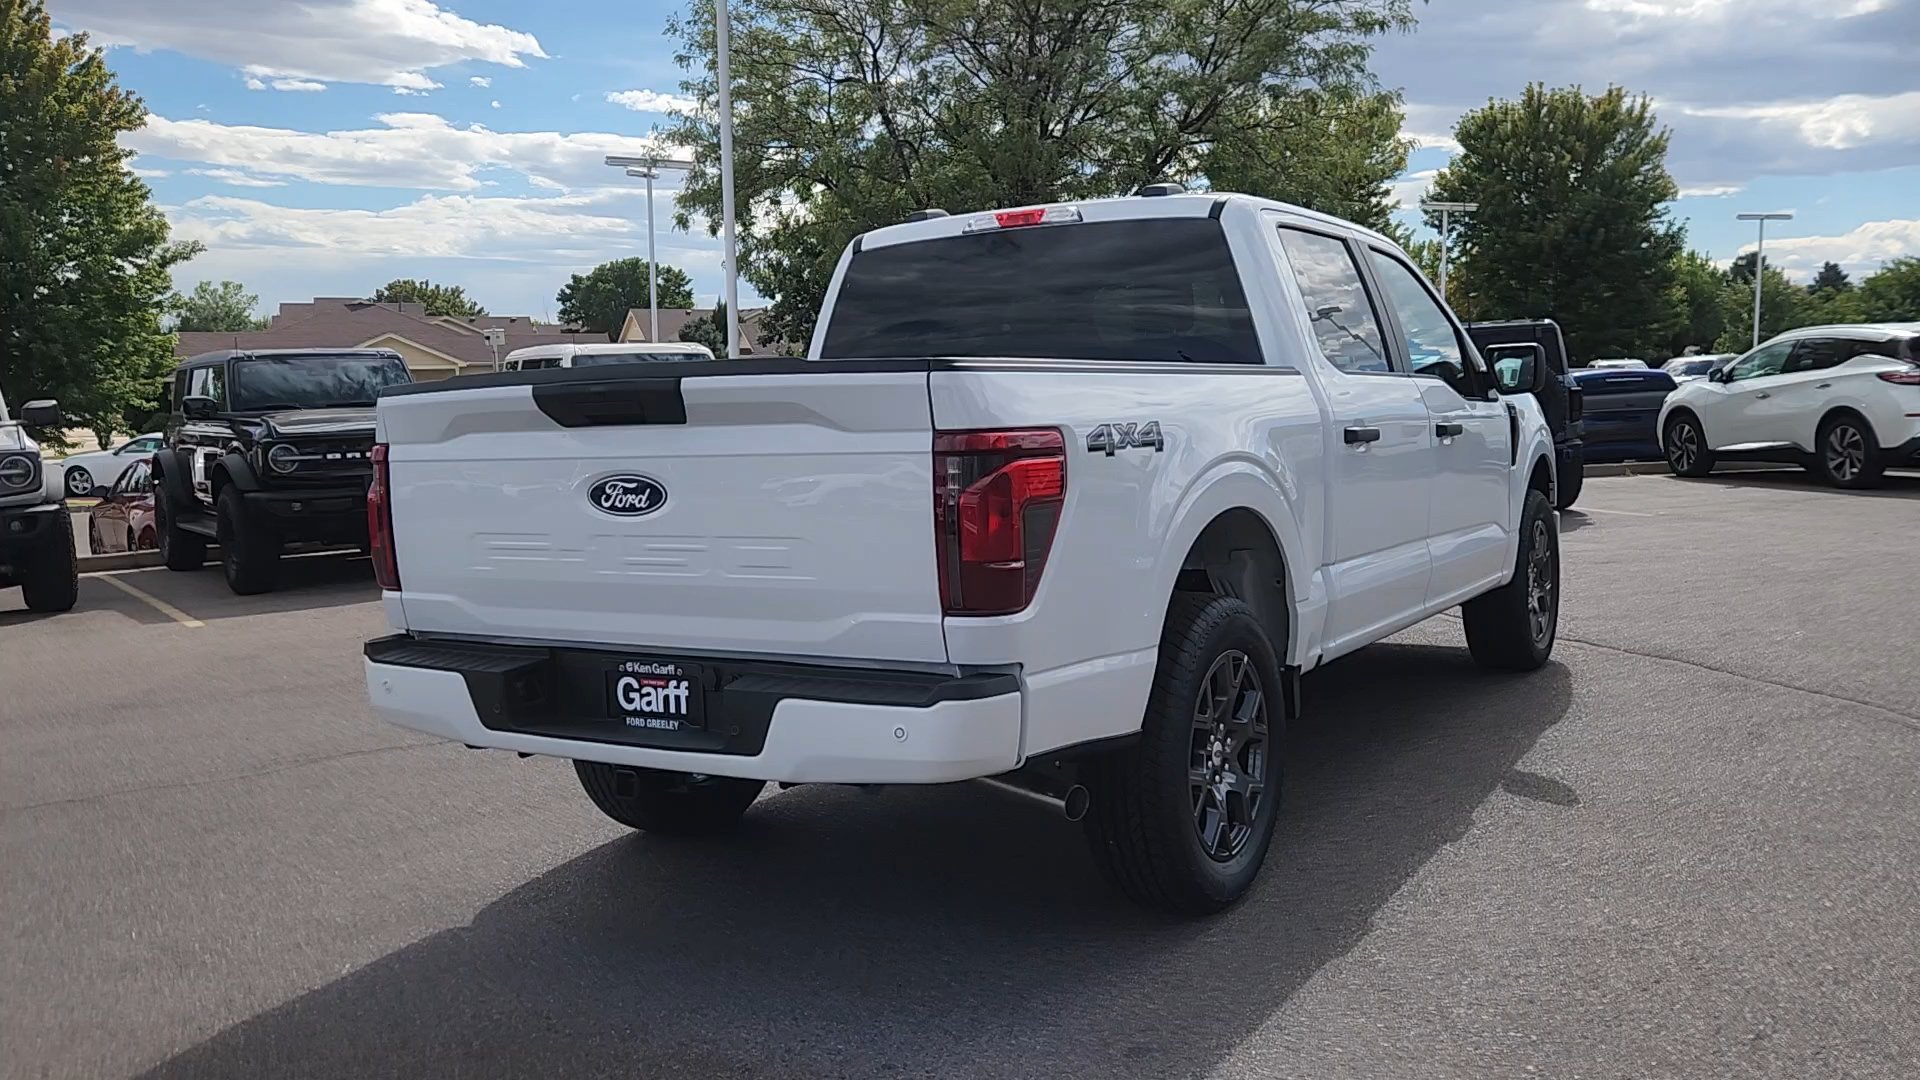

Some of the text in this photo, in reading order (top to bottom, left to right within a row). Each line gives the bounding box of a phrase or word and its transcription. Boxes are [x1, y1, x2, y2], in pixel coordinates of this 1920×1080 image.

[601, 481, 650, 508] Ford
[633, 662, 675, 675] Ken Garff
[616, 676, 689, 715] Garff
[626, 717, 679, 730] FORD GREELEY
